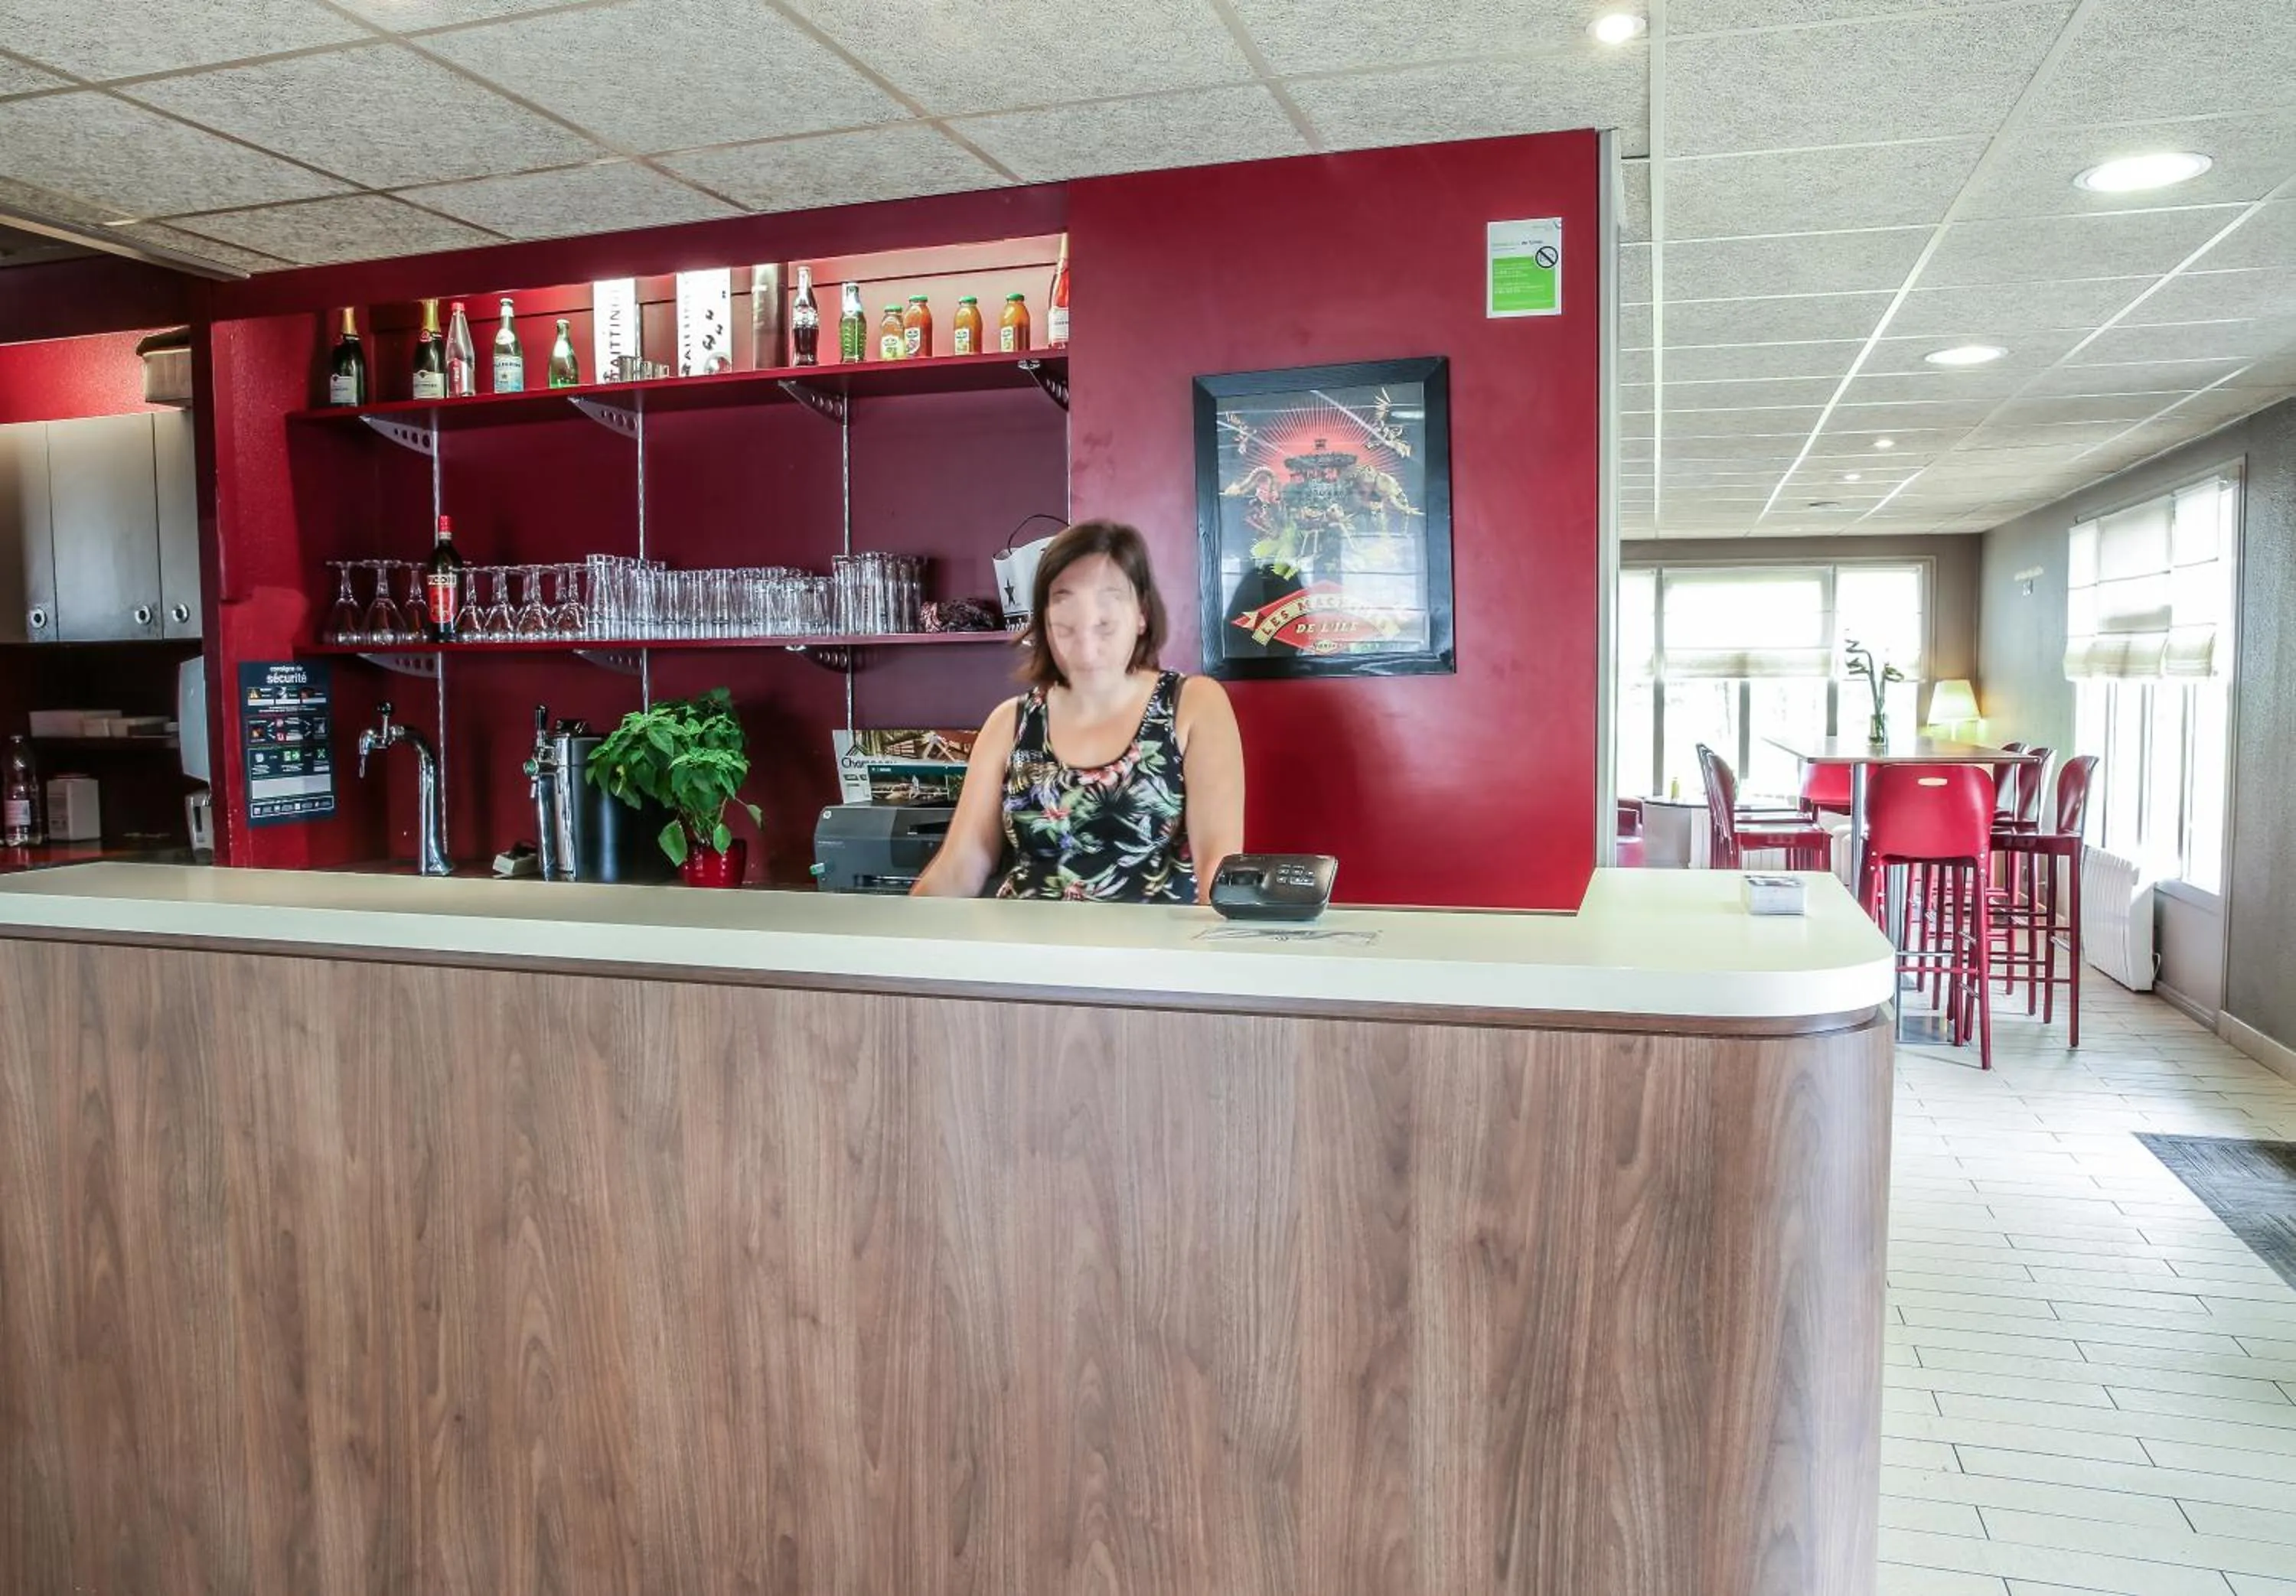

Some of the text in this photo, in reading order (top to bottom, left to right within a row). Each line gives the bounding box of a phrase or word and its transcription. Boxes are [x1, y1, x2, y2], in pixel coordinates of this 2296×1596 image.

[1263, 610, 1287, 637] LES
[1296, 624, 1315, 634] DE
[266, 672, 307, 683] sécurité
